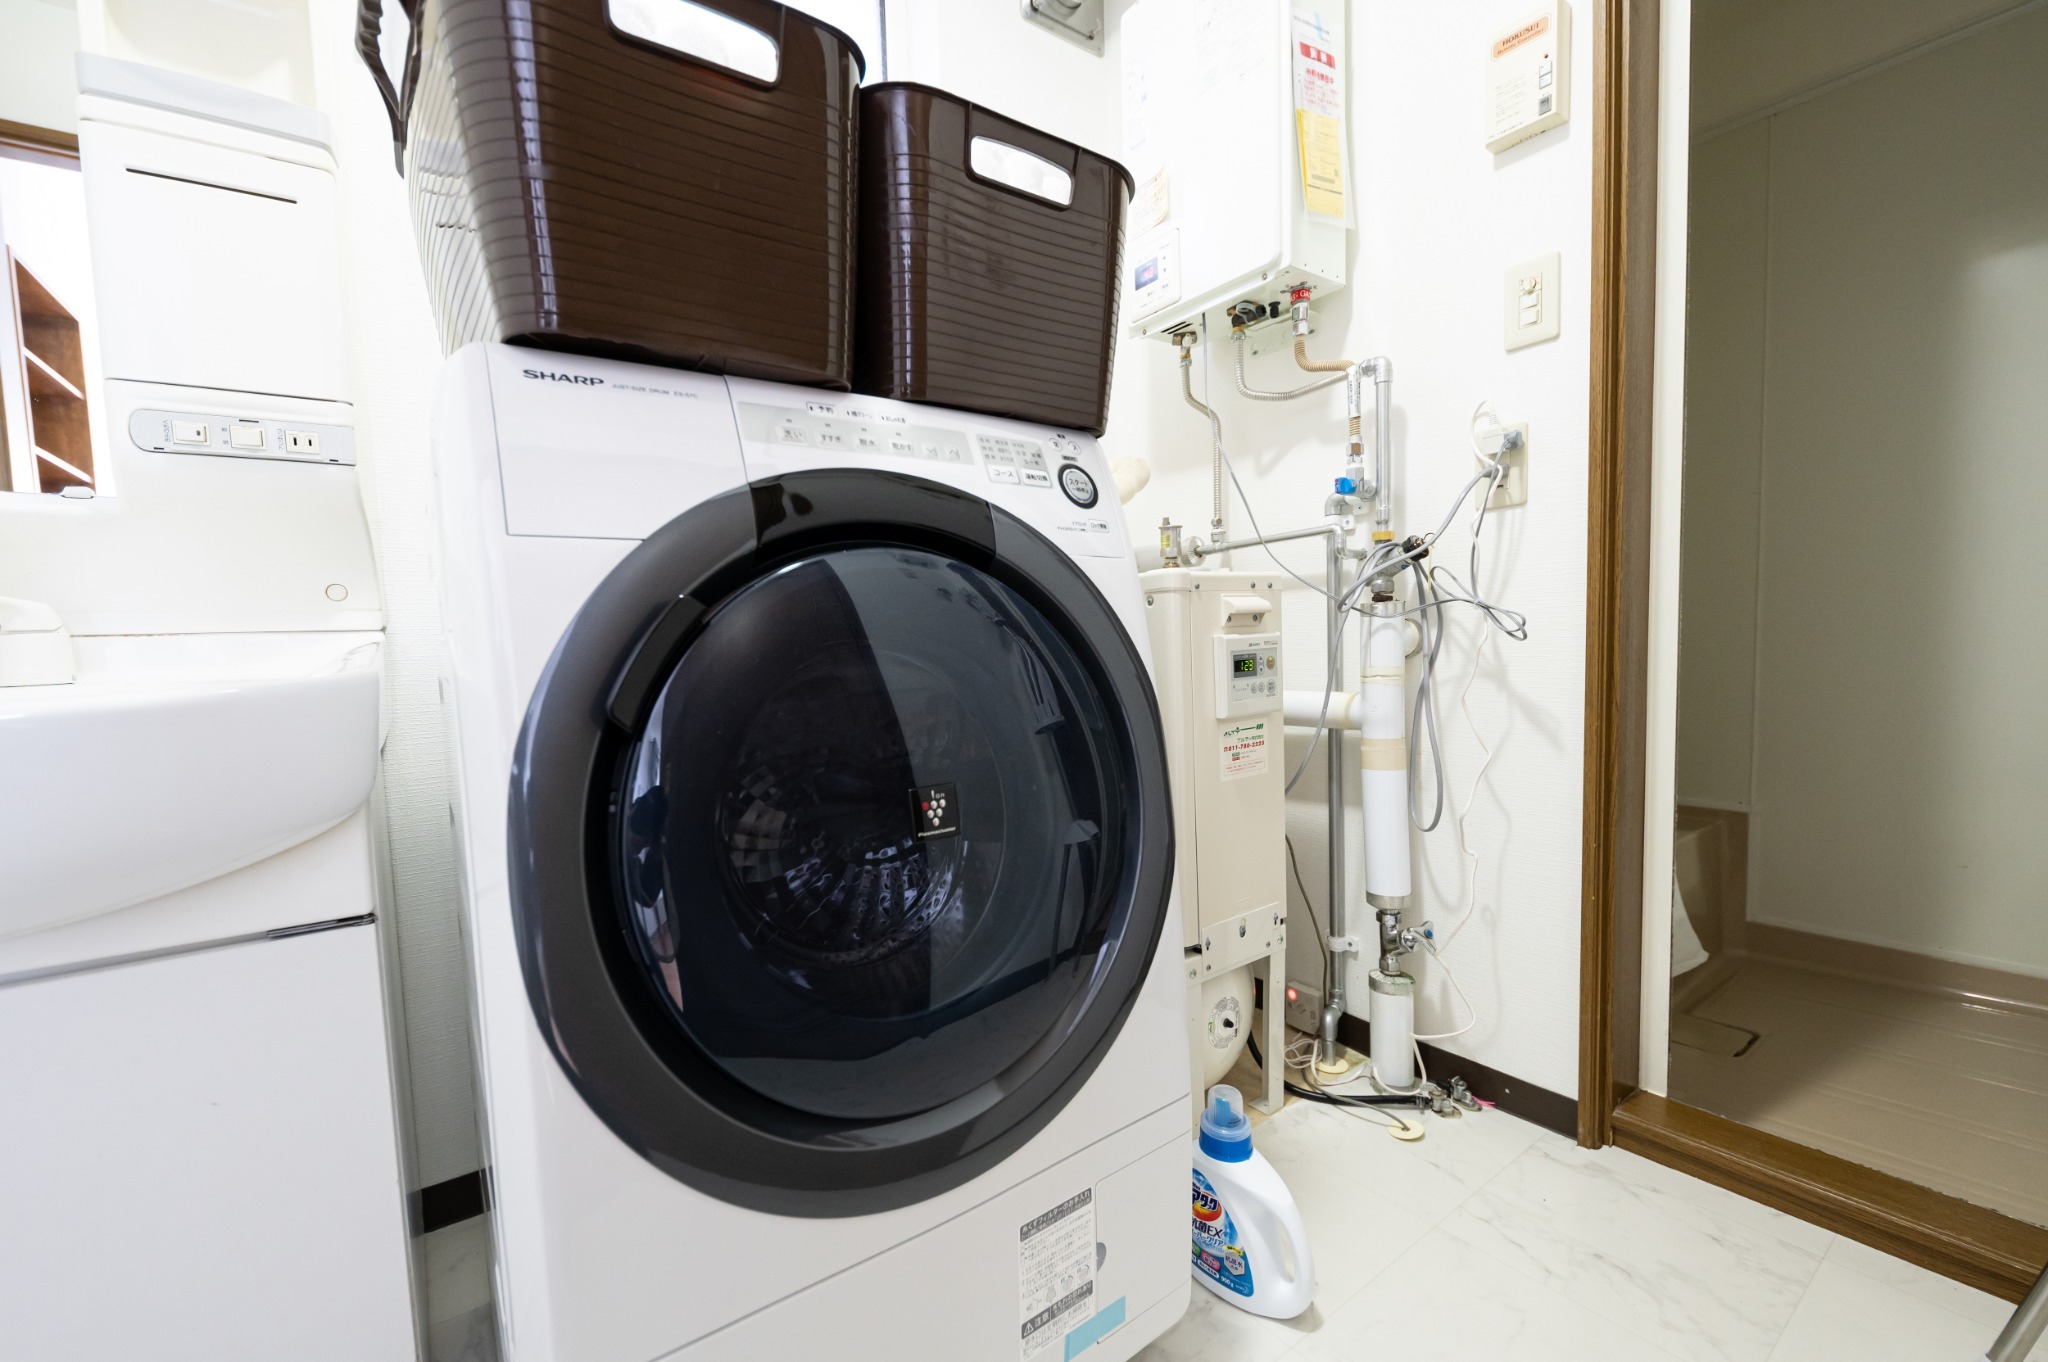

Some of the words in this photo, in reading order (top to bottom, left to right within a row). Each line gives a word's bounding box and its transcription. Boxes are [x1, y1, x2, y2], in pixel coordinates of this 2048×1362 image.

[1502, 22, 1540, 47] HOKUSUI
[522, 369, 605, 386] SHARP
[649, 387, 670, 395] DRUM
[820, 433, 842, 443] すすぎ
[994, 469, 1014, 478] コース
[1068, 478, 1088, 487] スタート
[931, 789, 945, 799] Ion
[918, 826, 956, 838] Plasmacluster
